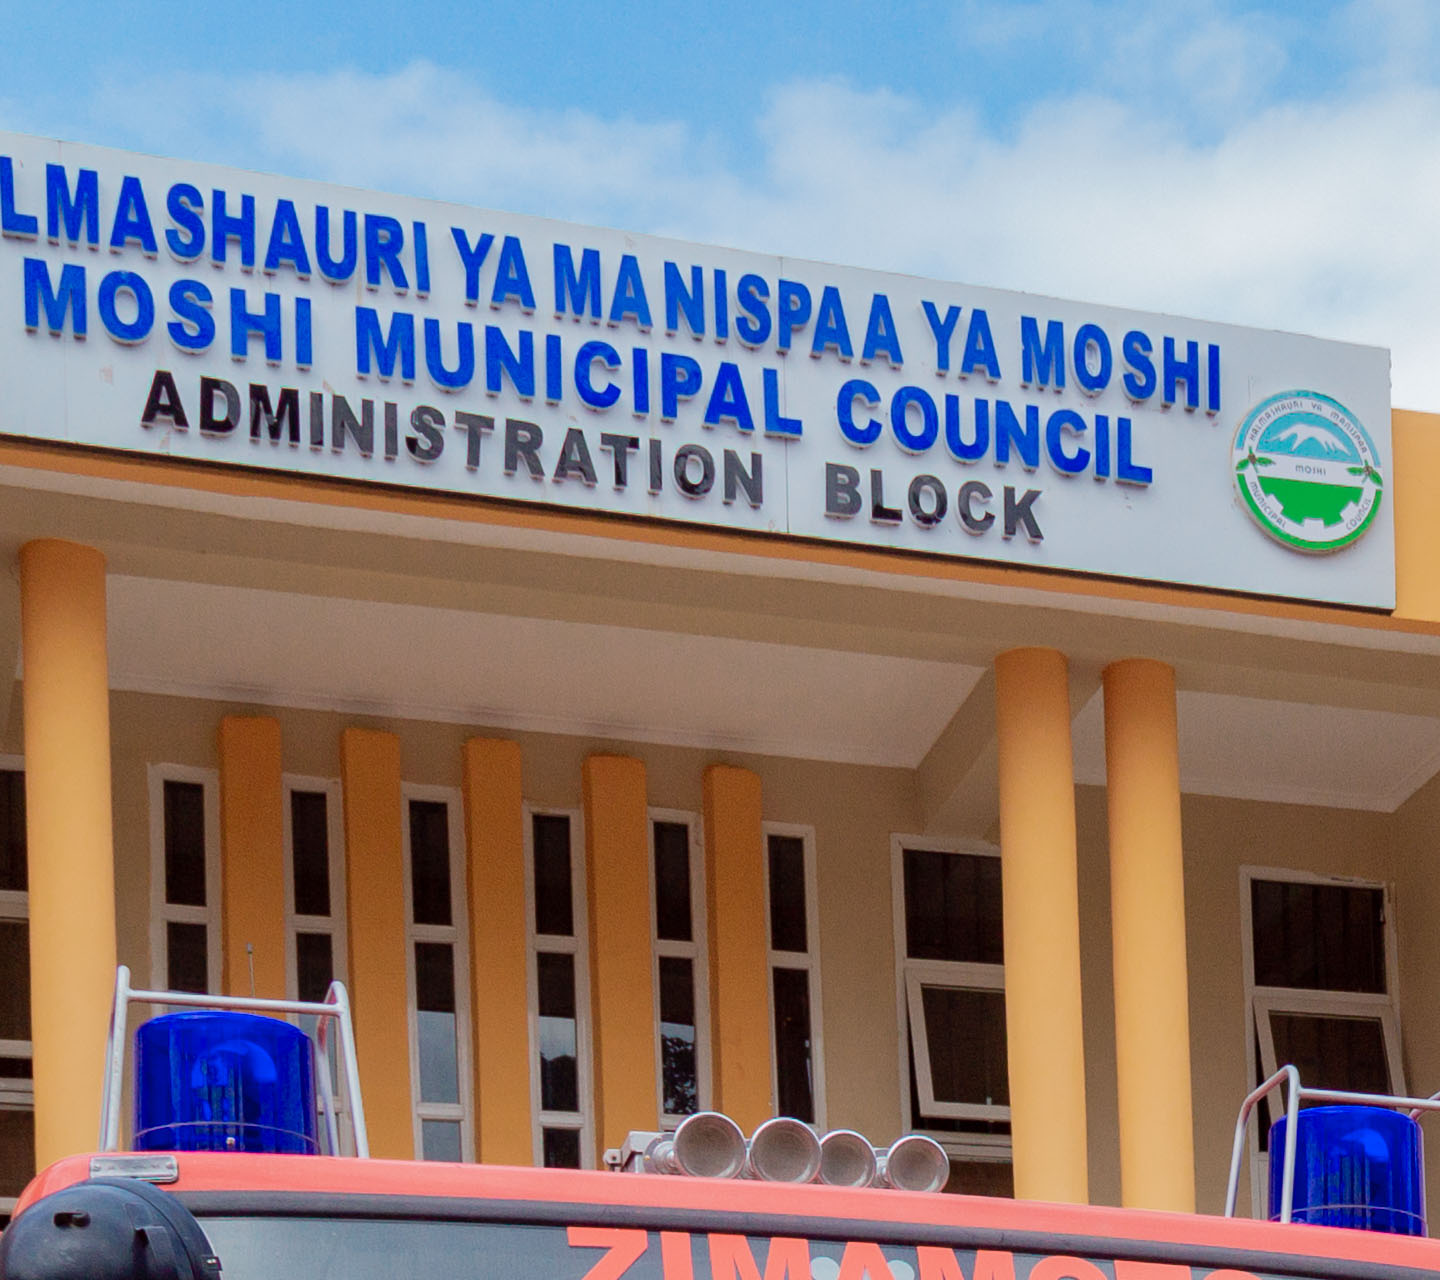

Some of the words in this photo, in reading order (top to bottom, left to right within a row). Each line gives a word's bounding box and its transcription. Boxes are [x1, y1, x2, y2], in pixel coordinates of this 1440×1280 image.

[23, 257, 313, 366] MOSHI
[356, 306, 803, 437] MUNICIPAL
[836, 379, 1153, 485] COUNCIL
[450, 227, 537, 310] YA
[553, 243, 904, 365] MANISPAA
[921, 300, 1001, 379] YA
[1021, 315, 1221, 412] MOSHI
[141, 370, 763, 505] ADMINISTRATION
[825, 462, 1044, 541] BLOCK
[1250, 400, 1303, 441] HALMASHAURI
[1330, 411, 1368, 454] MANISPAA
[1295, 464, 1327, 476] MOSHI
[1249, 481, 1287, 529] MUNICIPAL
[1345, 498, 1372, 531] COUNCIL
